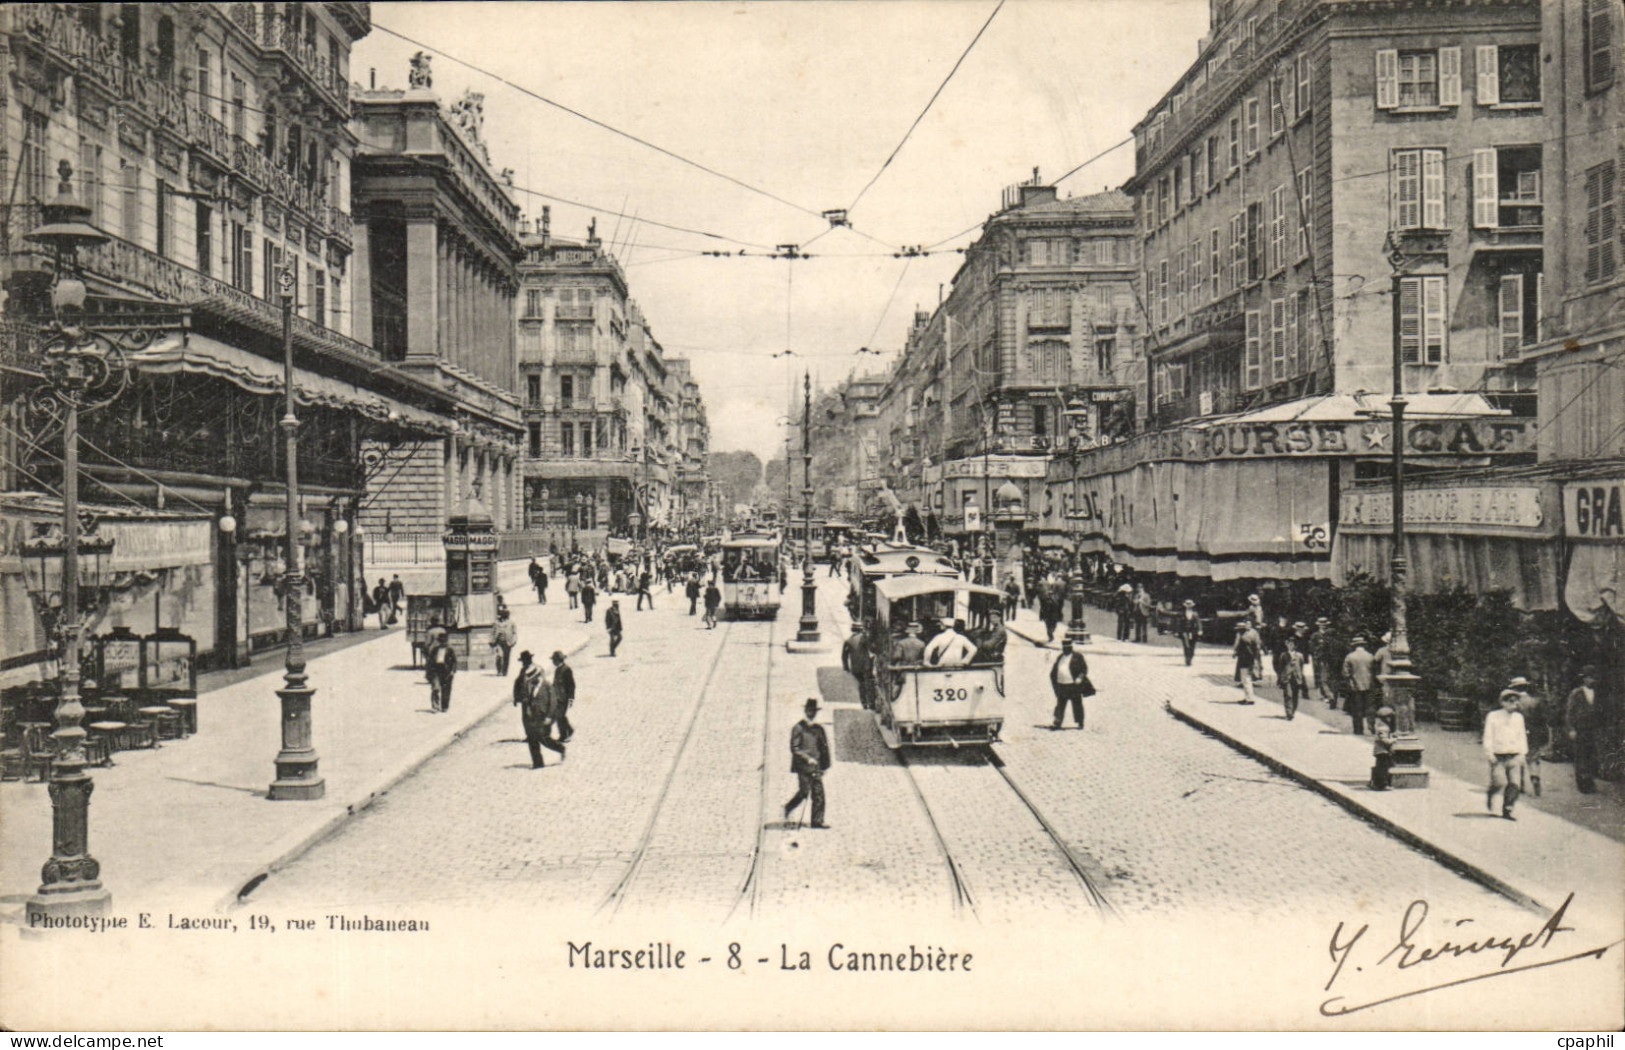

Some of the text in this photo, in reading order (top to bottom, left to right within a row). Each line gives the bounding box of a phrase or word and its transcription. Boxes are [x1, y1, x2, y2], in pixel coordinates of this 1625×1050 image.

[1408, 422, 1538, 453] CAF
[1576, 486, 1624, 536] GRA
[933, 688, 968, 702] 320
